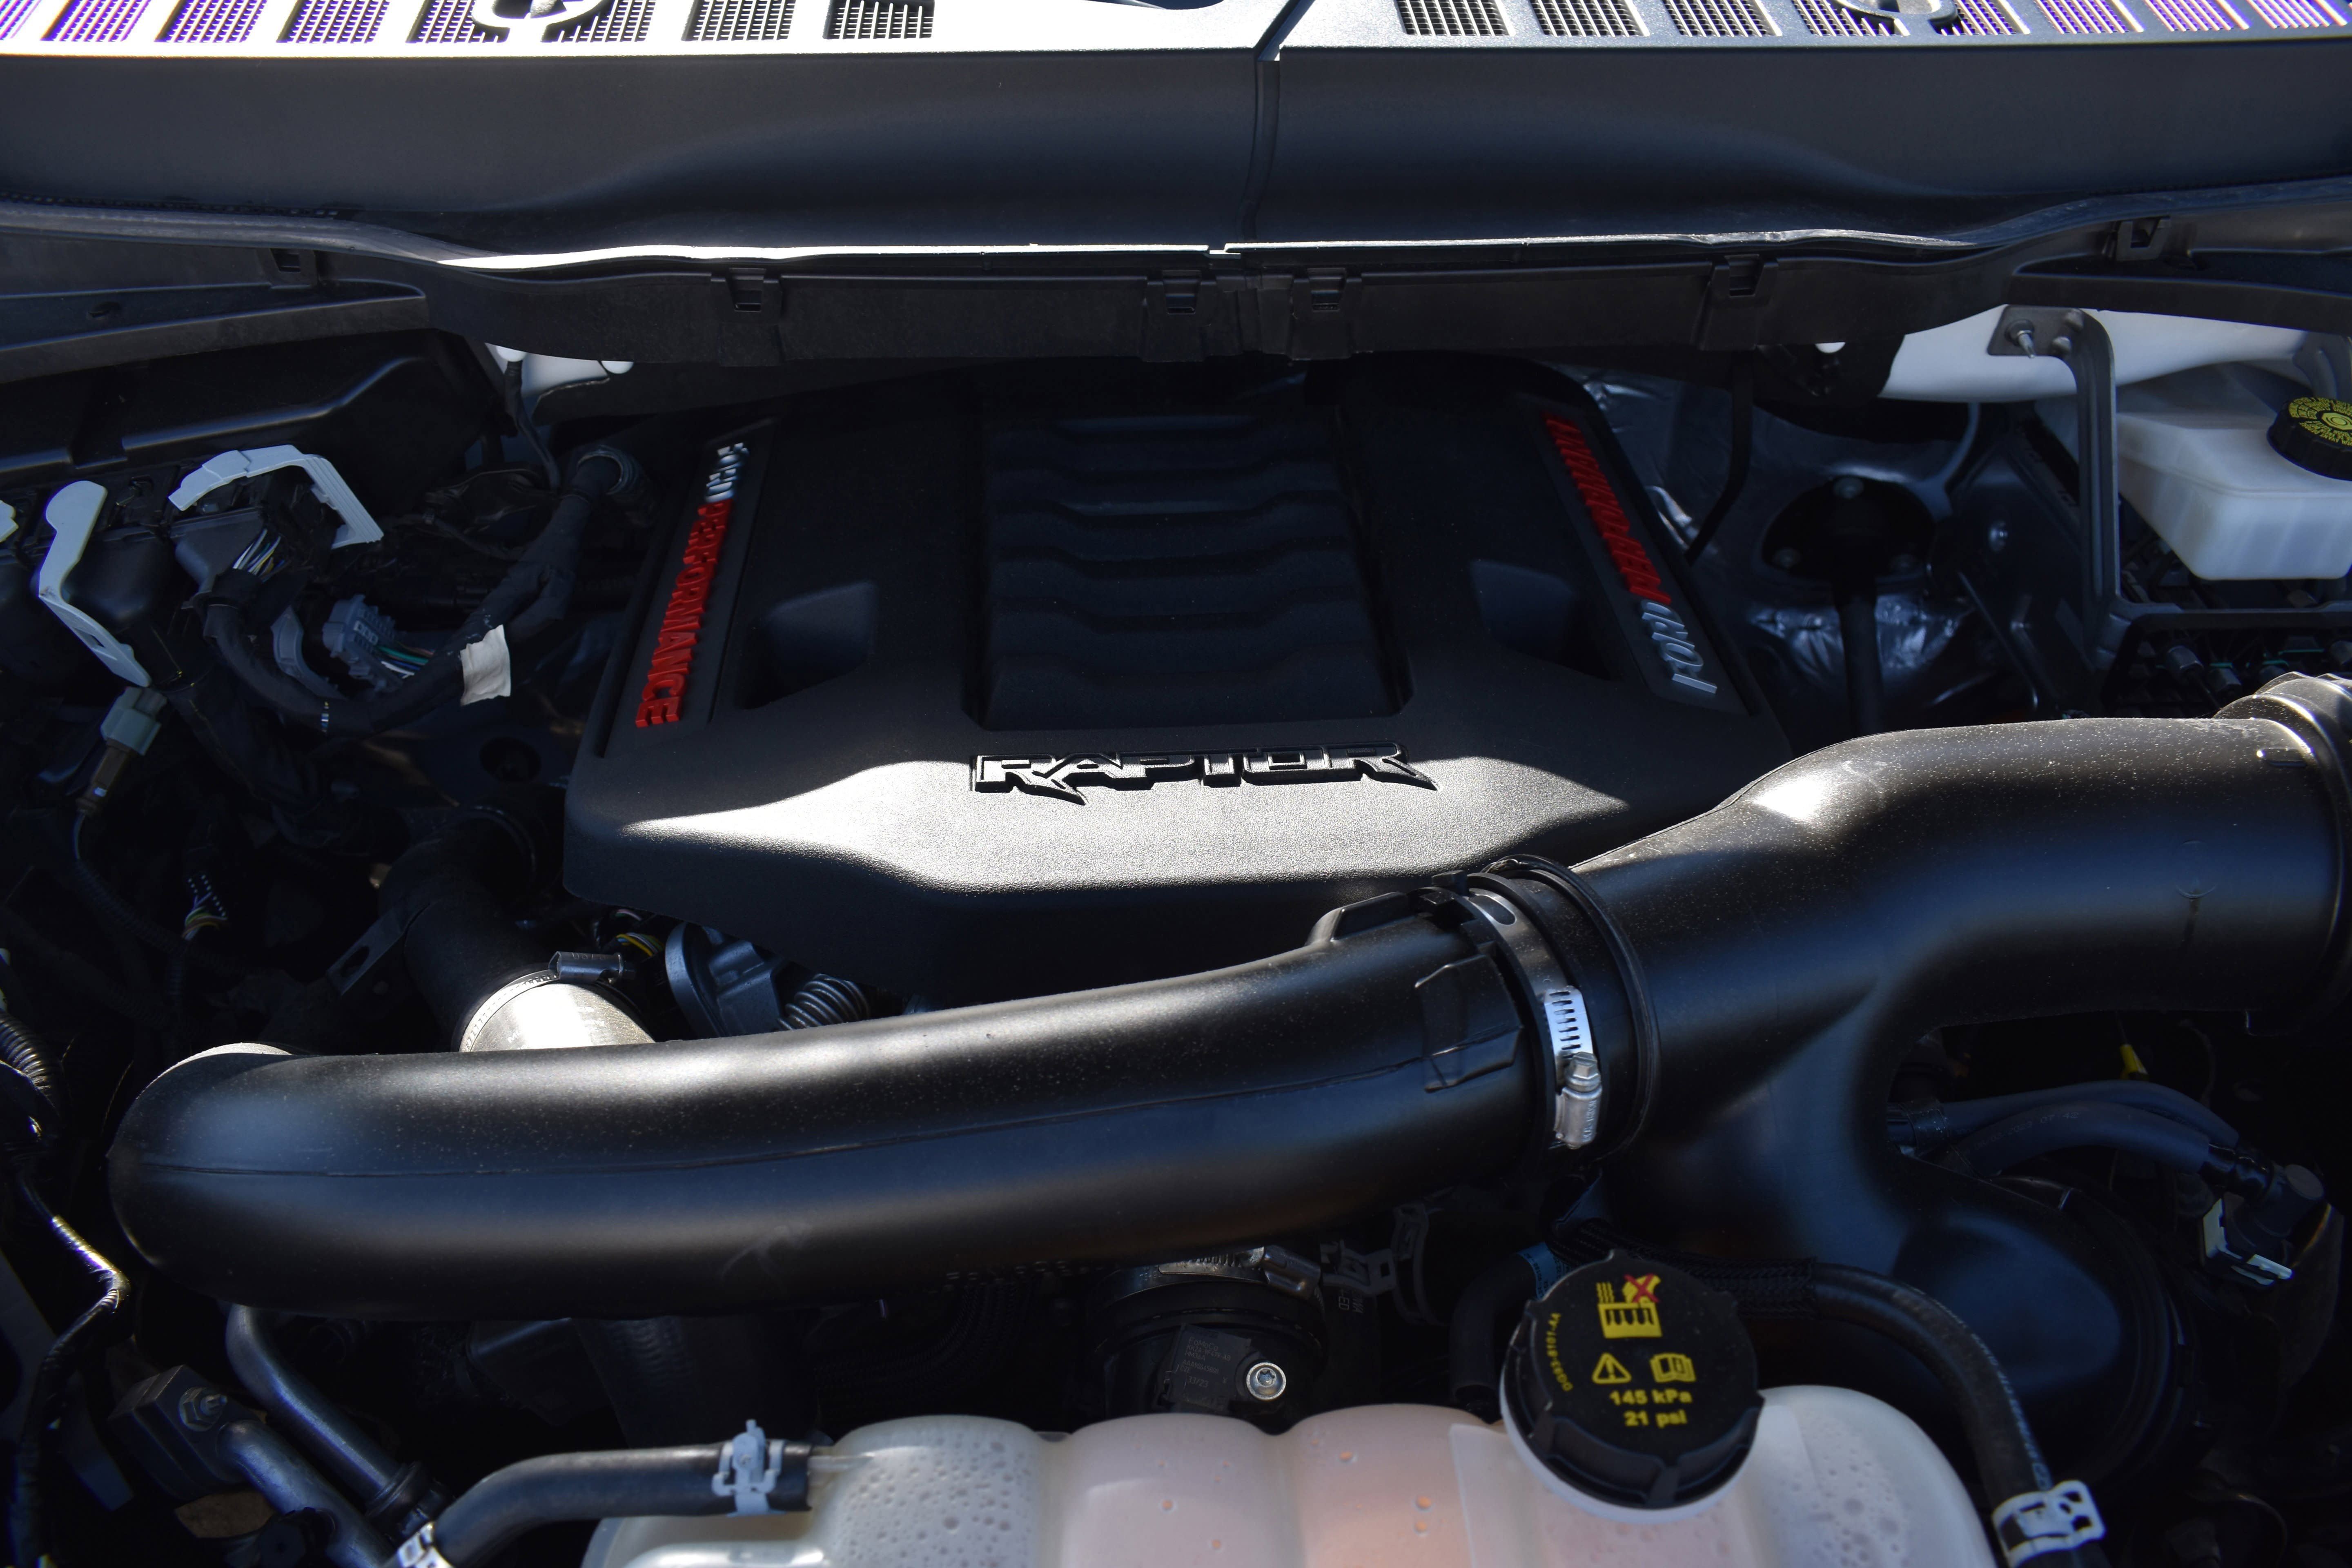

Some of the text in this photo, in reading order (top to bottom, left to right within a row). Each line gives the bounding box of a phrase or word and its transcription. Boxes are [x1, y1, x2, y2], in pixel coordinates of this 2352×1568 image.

[636, 500, 731, 728] PERFORMANCE
[1640, 600, 1717, 694] FORD
[971, 742, 1439, 805] RAPTOR
[1189, 1336, 1219, 1351] FoMoCo
[1610, 1388, 1693, 1405] 145 kPa
[1624, 1410, 1687, 1428] 21 psi
